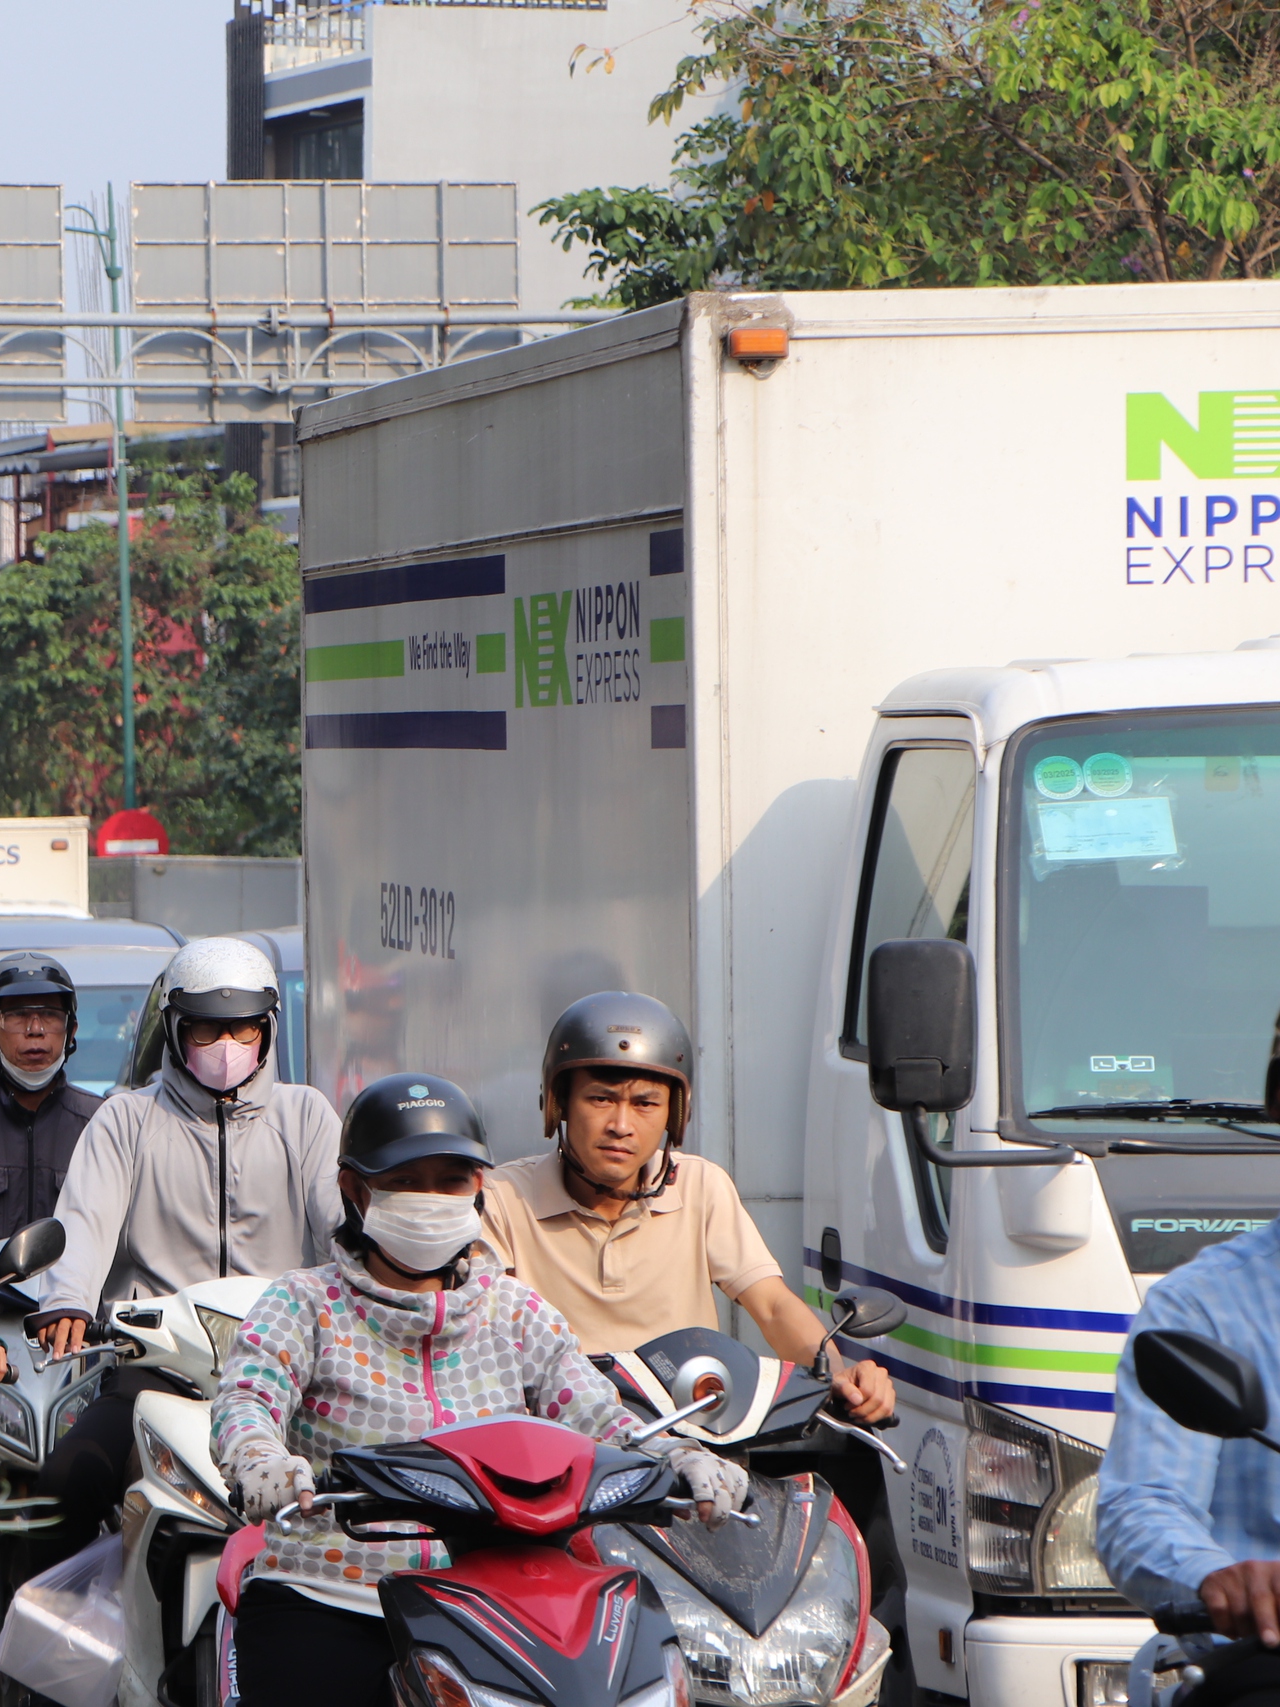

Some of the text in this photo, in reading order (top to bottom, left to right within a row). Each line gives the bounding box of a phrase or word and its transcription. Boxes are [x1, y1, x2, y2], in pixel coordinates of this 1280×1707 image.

[1126, 544, 1275, 585] EXPR
[576, 580, 640, 644] NIPPON
[409, 630, 471, 679] We Find the Way
[576, 648, 641, 704] EXPRESS
[1043, 769, 1075, 778] 03/2025
[381, 882, 455, 960] 52LD-3012
[397, 1098, 446, 1111] PIAGGIO
[604, 1594, 624, 1643] LUVIAS
